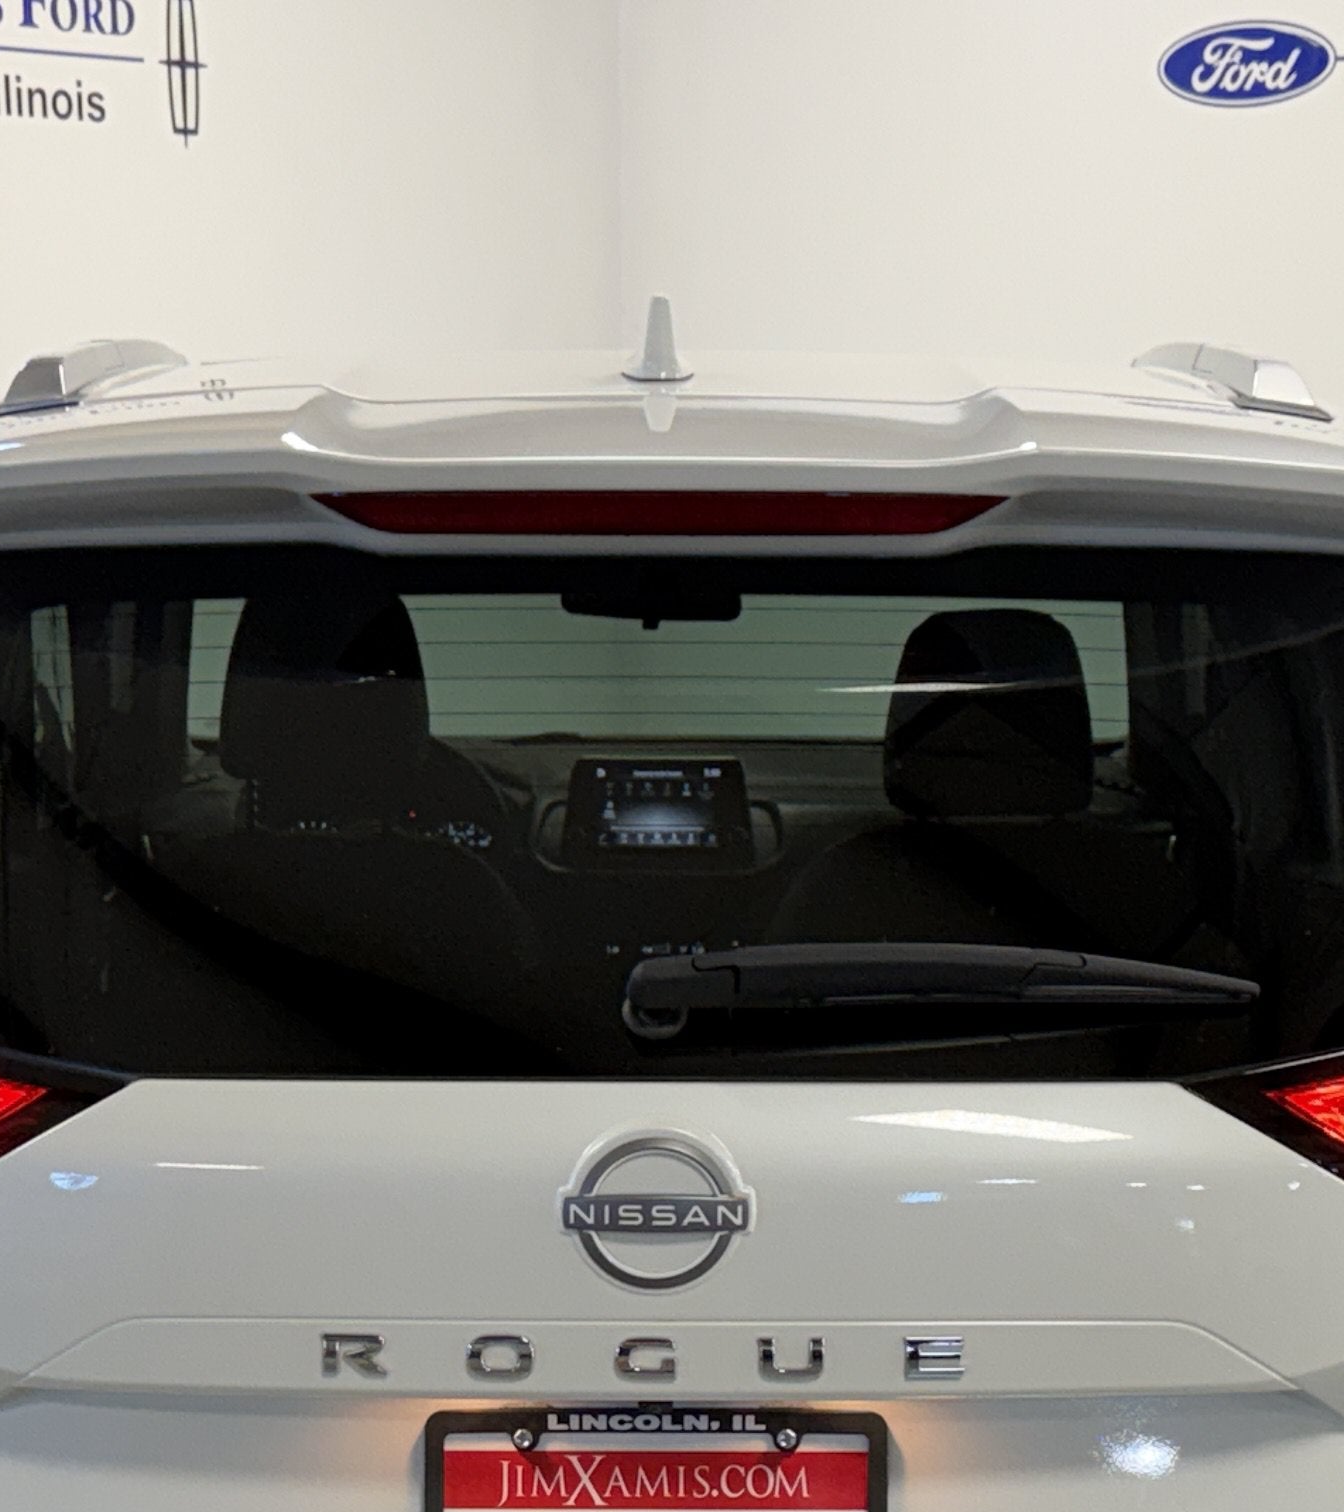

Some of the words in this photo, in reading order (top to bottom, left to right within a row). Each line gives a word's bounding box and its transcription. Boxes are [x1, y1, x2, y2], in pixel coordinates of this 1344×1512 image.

[1191, 36, 1299, 92] Ford
[568, 1203, 744, 1227] NISSAN
[321, 1333, 965, 1380] ROGUE
[547, 1413, 720, 1432] LINCOLN,
[732, 1414, 767, 1432] IL
[497, 1454, 810, 1507] JIMXAMIS.COM
